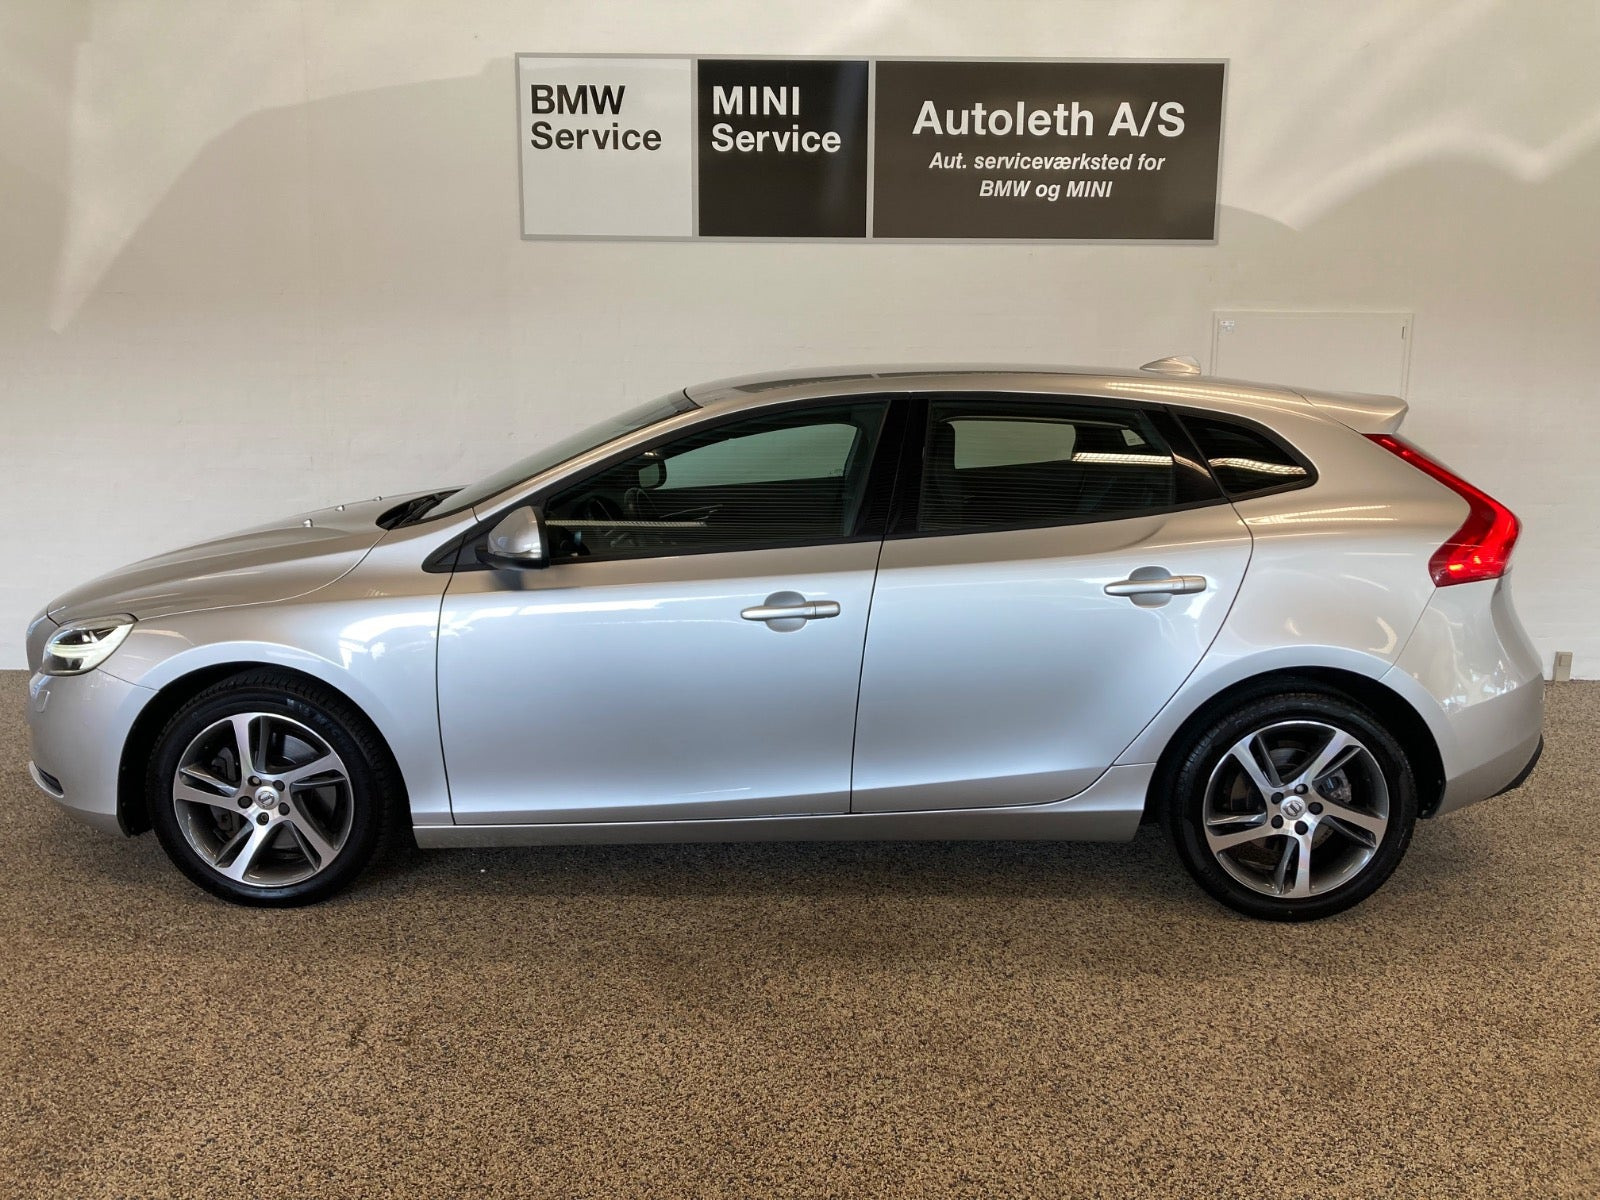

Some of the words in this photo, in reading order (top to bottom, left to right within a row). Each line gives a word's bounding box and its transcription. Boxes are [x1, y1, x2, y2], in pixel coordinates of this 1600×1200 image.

[530, 84, 626, 115] BMW
[712, 86, 800, 116] MINI
[912, 100, 1094, 136] Autoleth
[1108, 101, 1185, 138] A/S
[530, 121, 662, 151] Service
[711, 123, 842, 152] Service
[928, 151, 967, 169] Aut.
[974, 153, 1133, 171] serviceværksted
[1137, 154, 1166, 171] for
[979, 180, 1031, 197] BMW
[1035, 184, 1060, 202] og
[1066, 181, 1113, 198] MINI
